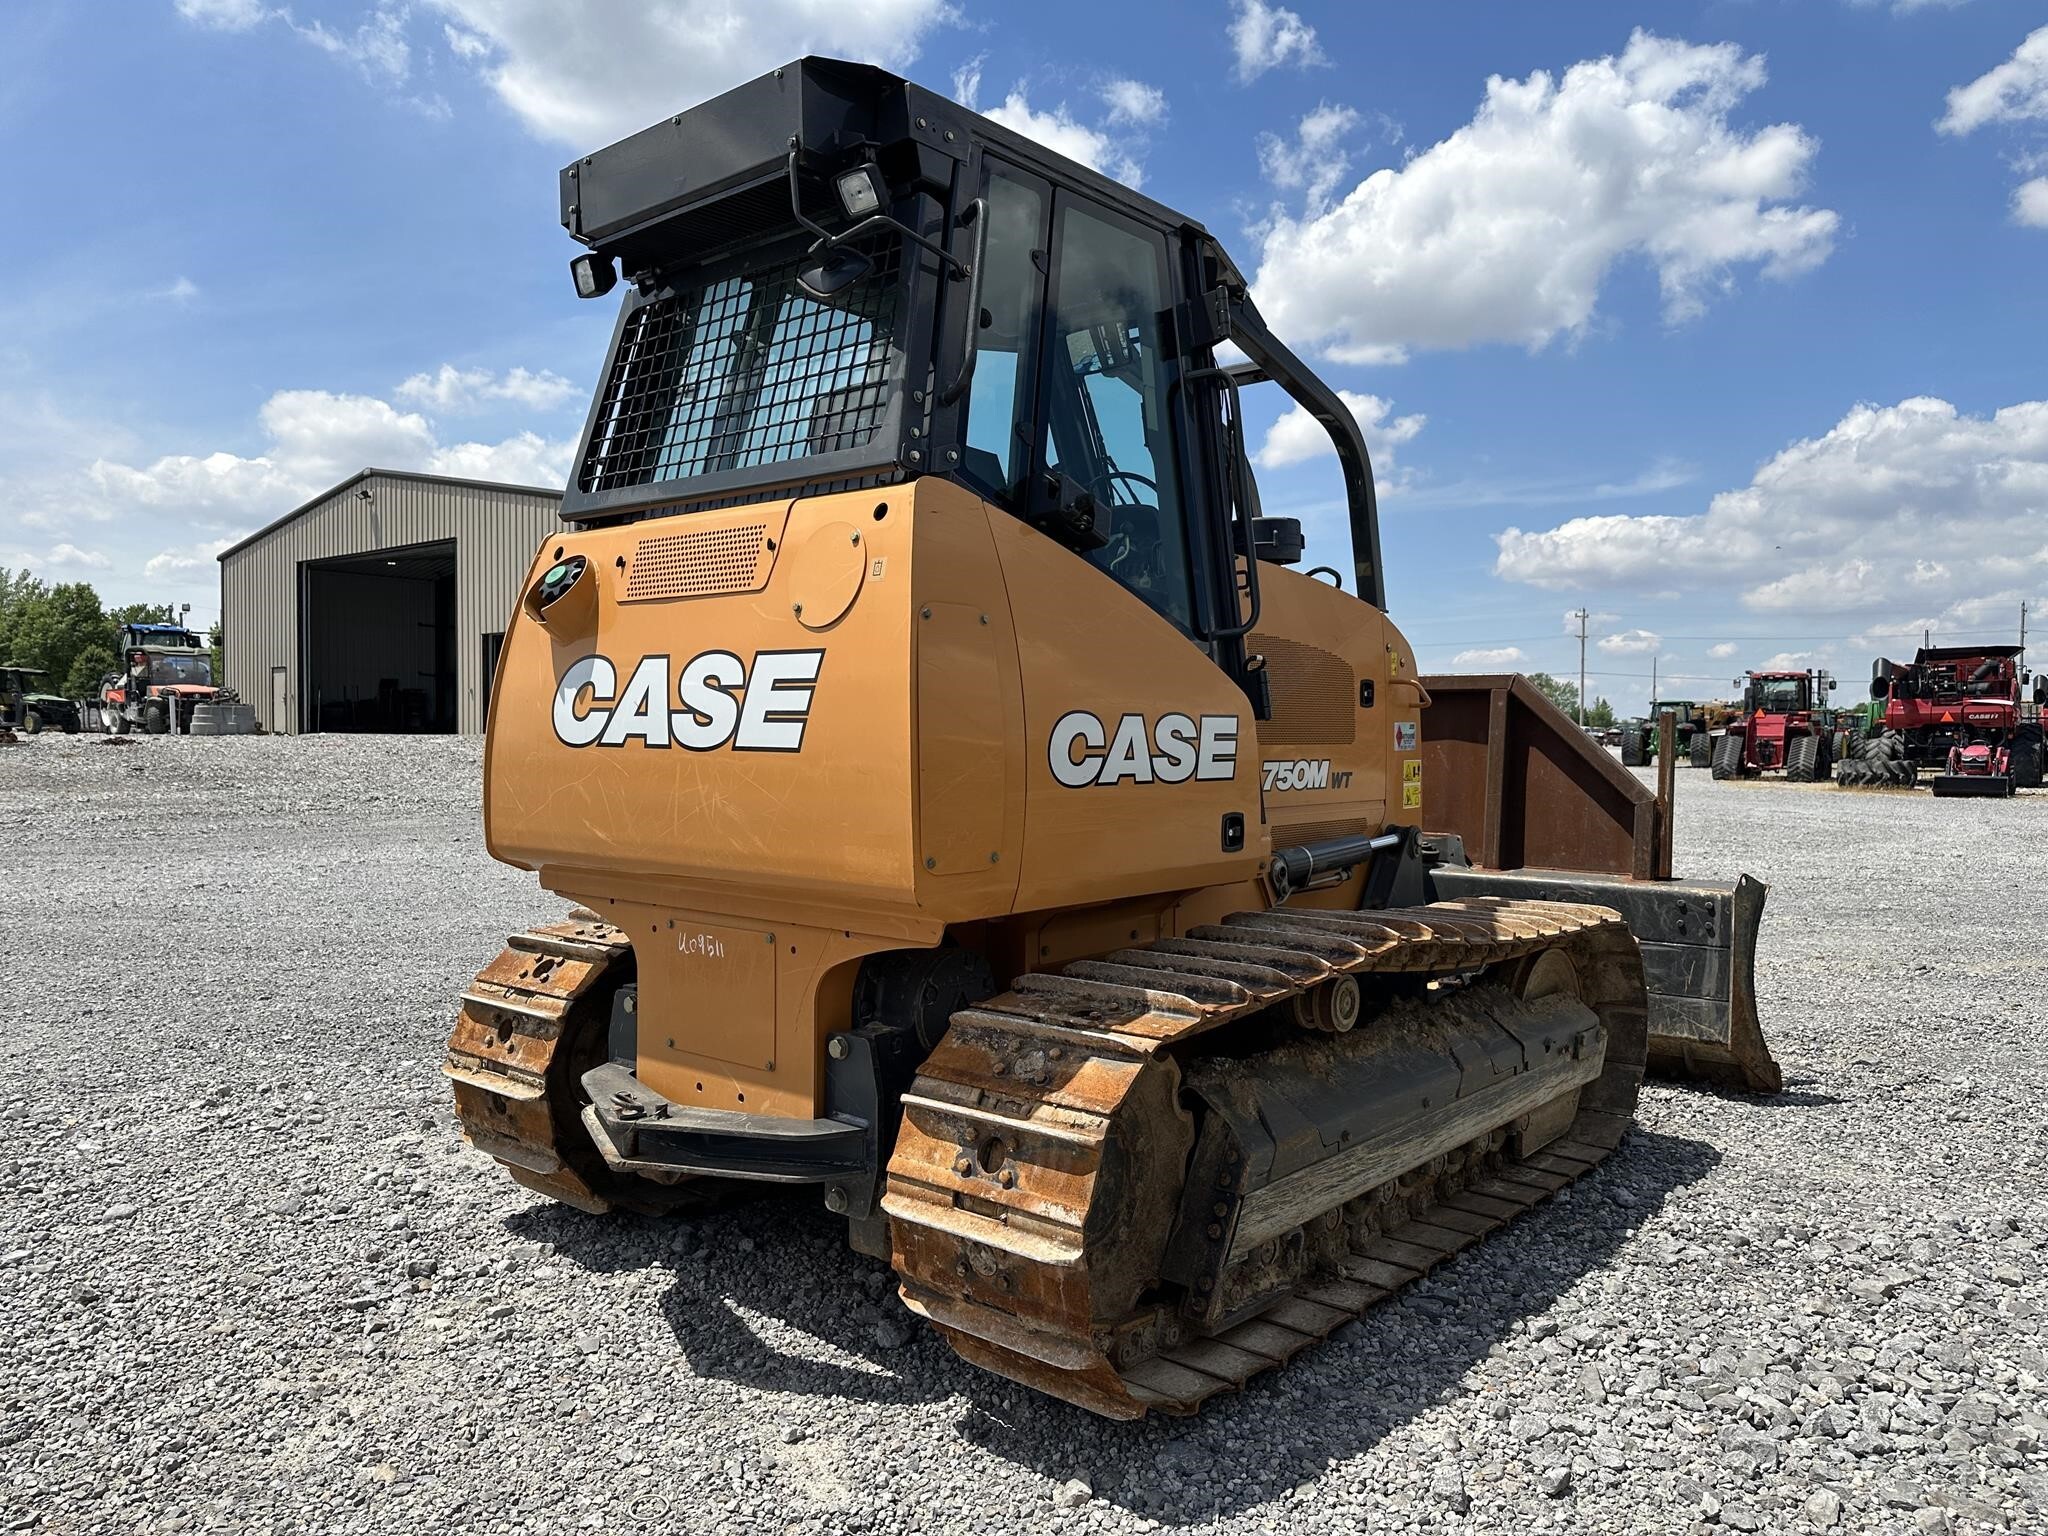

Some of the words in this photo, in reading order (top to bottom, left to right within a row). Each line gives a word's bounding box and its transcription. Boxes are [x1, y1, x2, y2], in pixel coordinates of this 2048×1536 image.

[552, 648, 826, 753] CASE
[1048, 710, 1239, 789] CASE
[1262, 759, 1331, 792] 750M
[1331, 771, 1353, 790] WT
